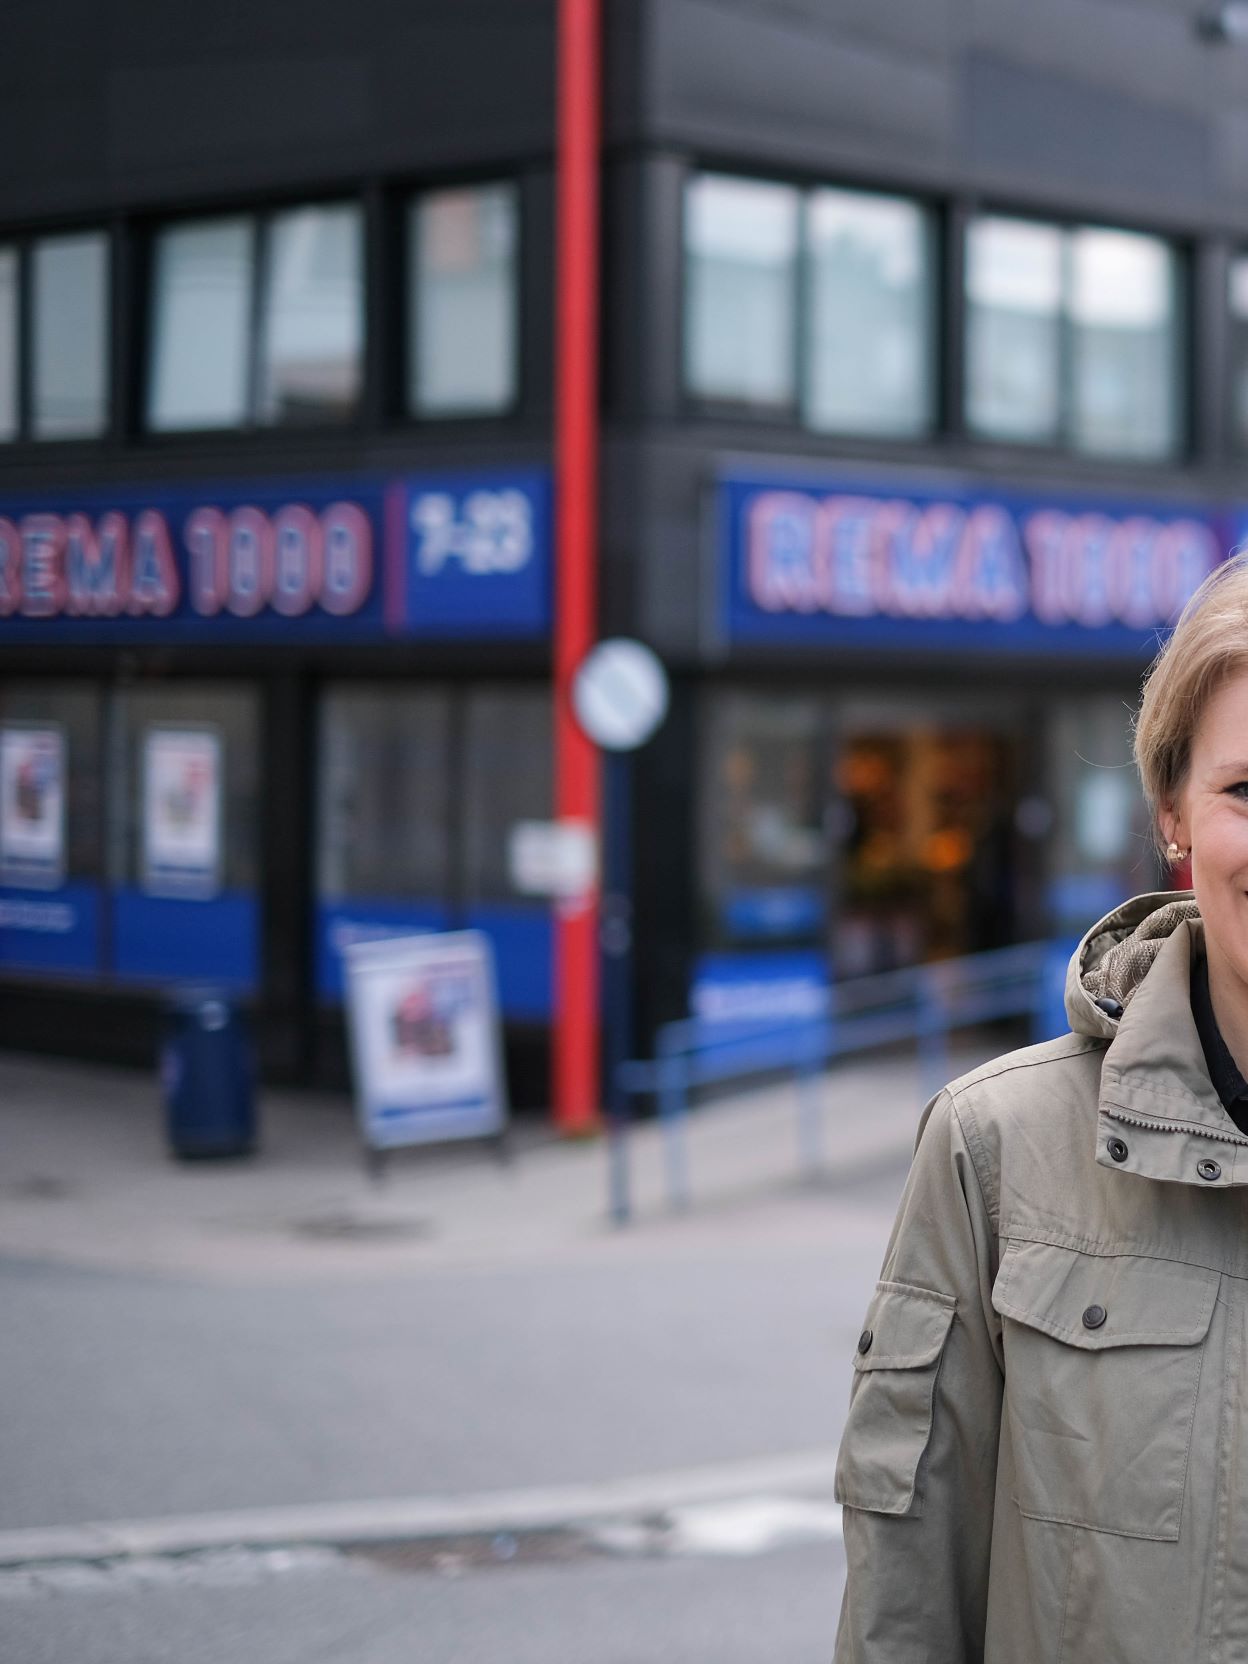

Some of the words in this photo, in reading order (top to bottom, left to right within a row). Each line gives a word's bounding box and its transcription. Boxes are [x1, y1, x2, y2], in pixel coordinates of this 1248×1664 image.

[185, 503, 373, 617] 1000
[748, 491, 1026, 623] REMA
[1027, 510, 1221, 631] 1000
